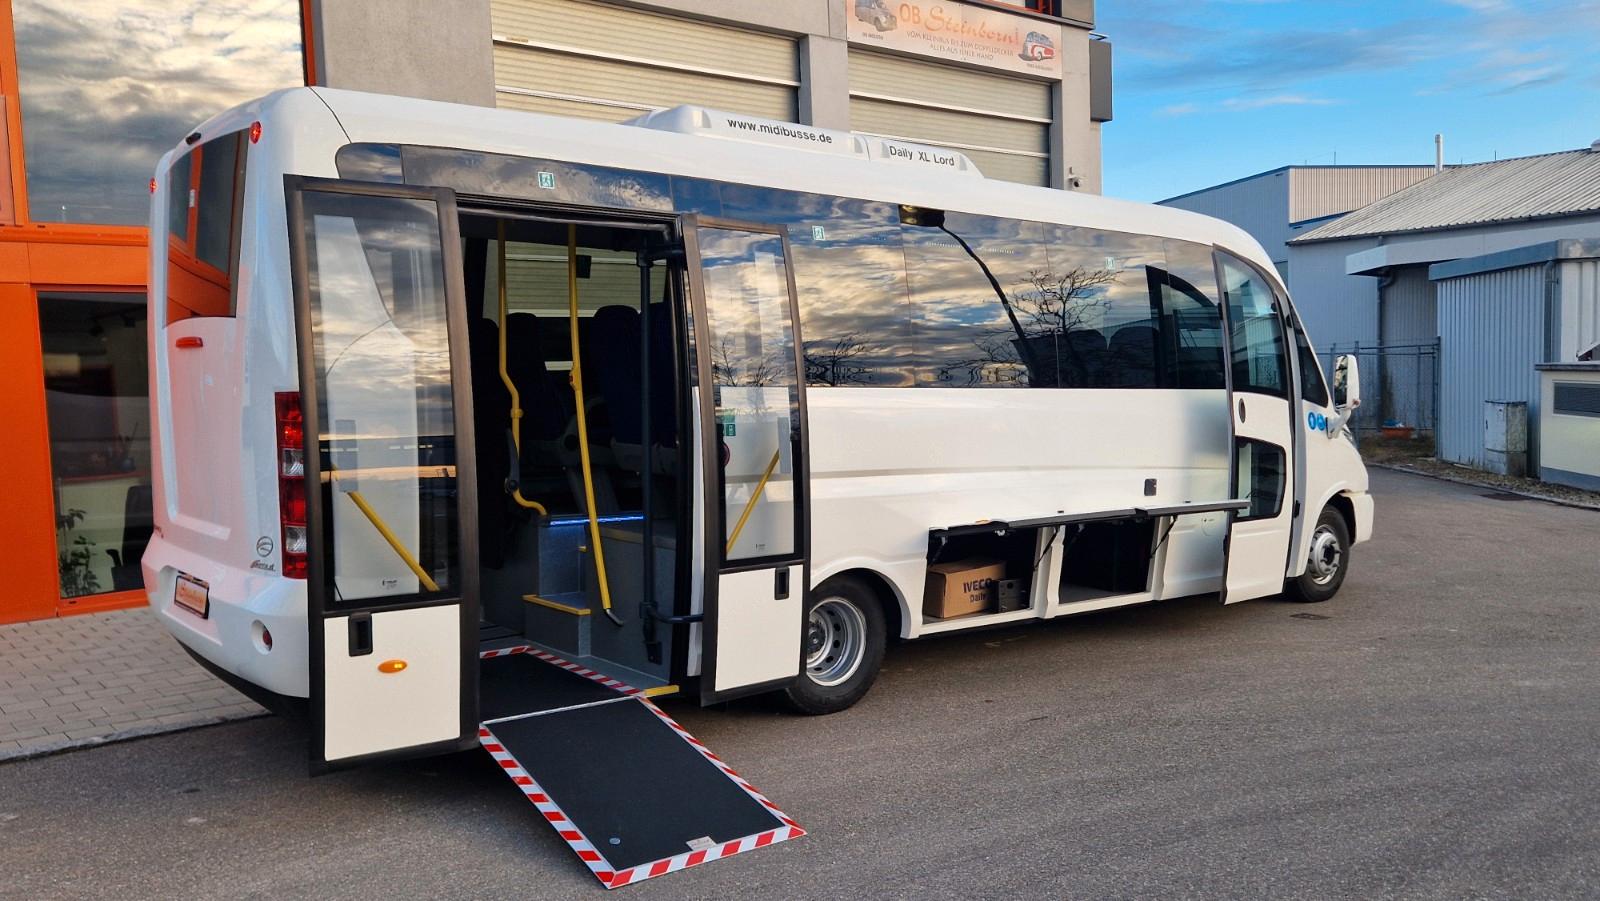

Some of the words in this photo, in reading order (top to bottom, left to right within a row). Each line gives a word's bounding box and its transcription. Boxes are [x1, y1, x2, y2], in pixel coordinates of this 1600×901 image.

[899, 3, 921, 25] OB
[727, 119, 833, 144] www.midibusse.de
[889, 145, 913, 161] Daily
[918, 151, 931, 162] XL
[933, 153, 955, 166] Lord
[963, 577, 993, 593] IVECO
